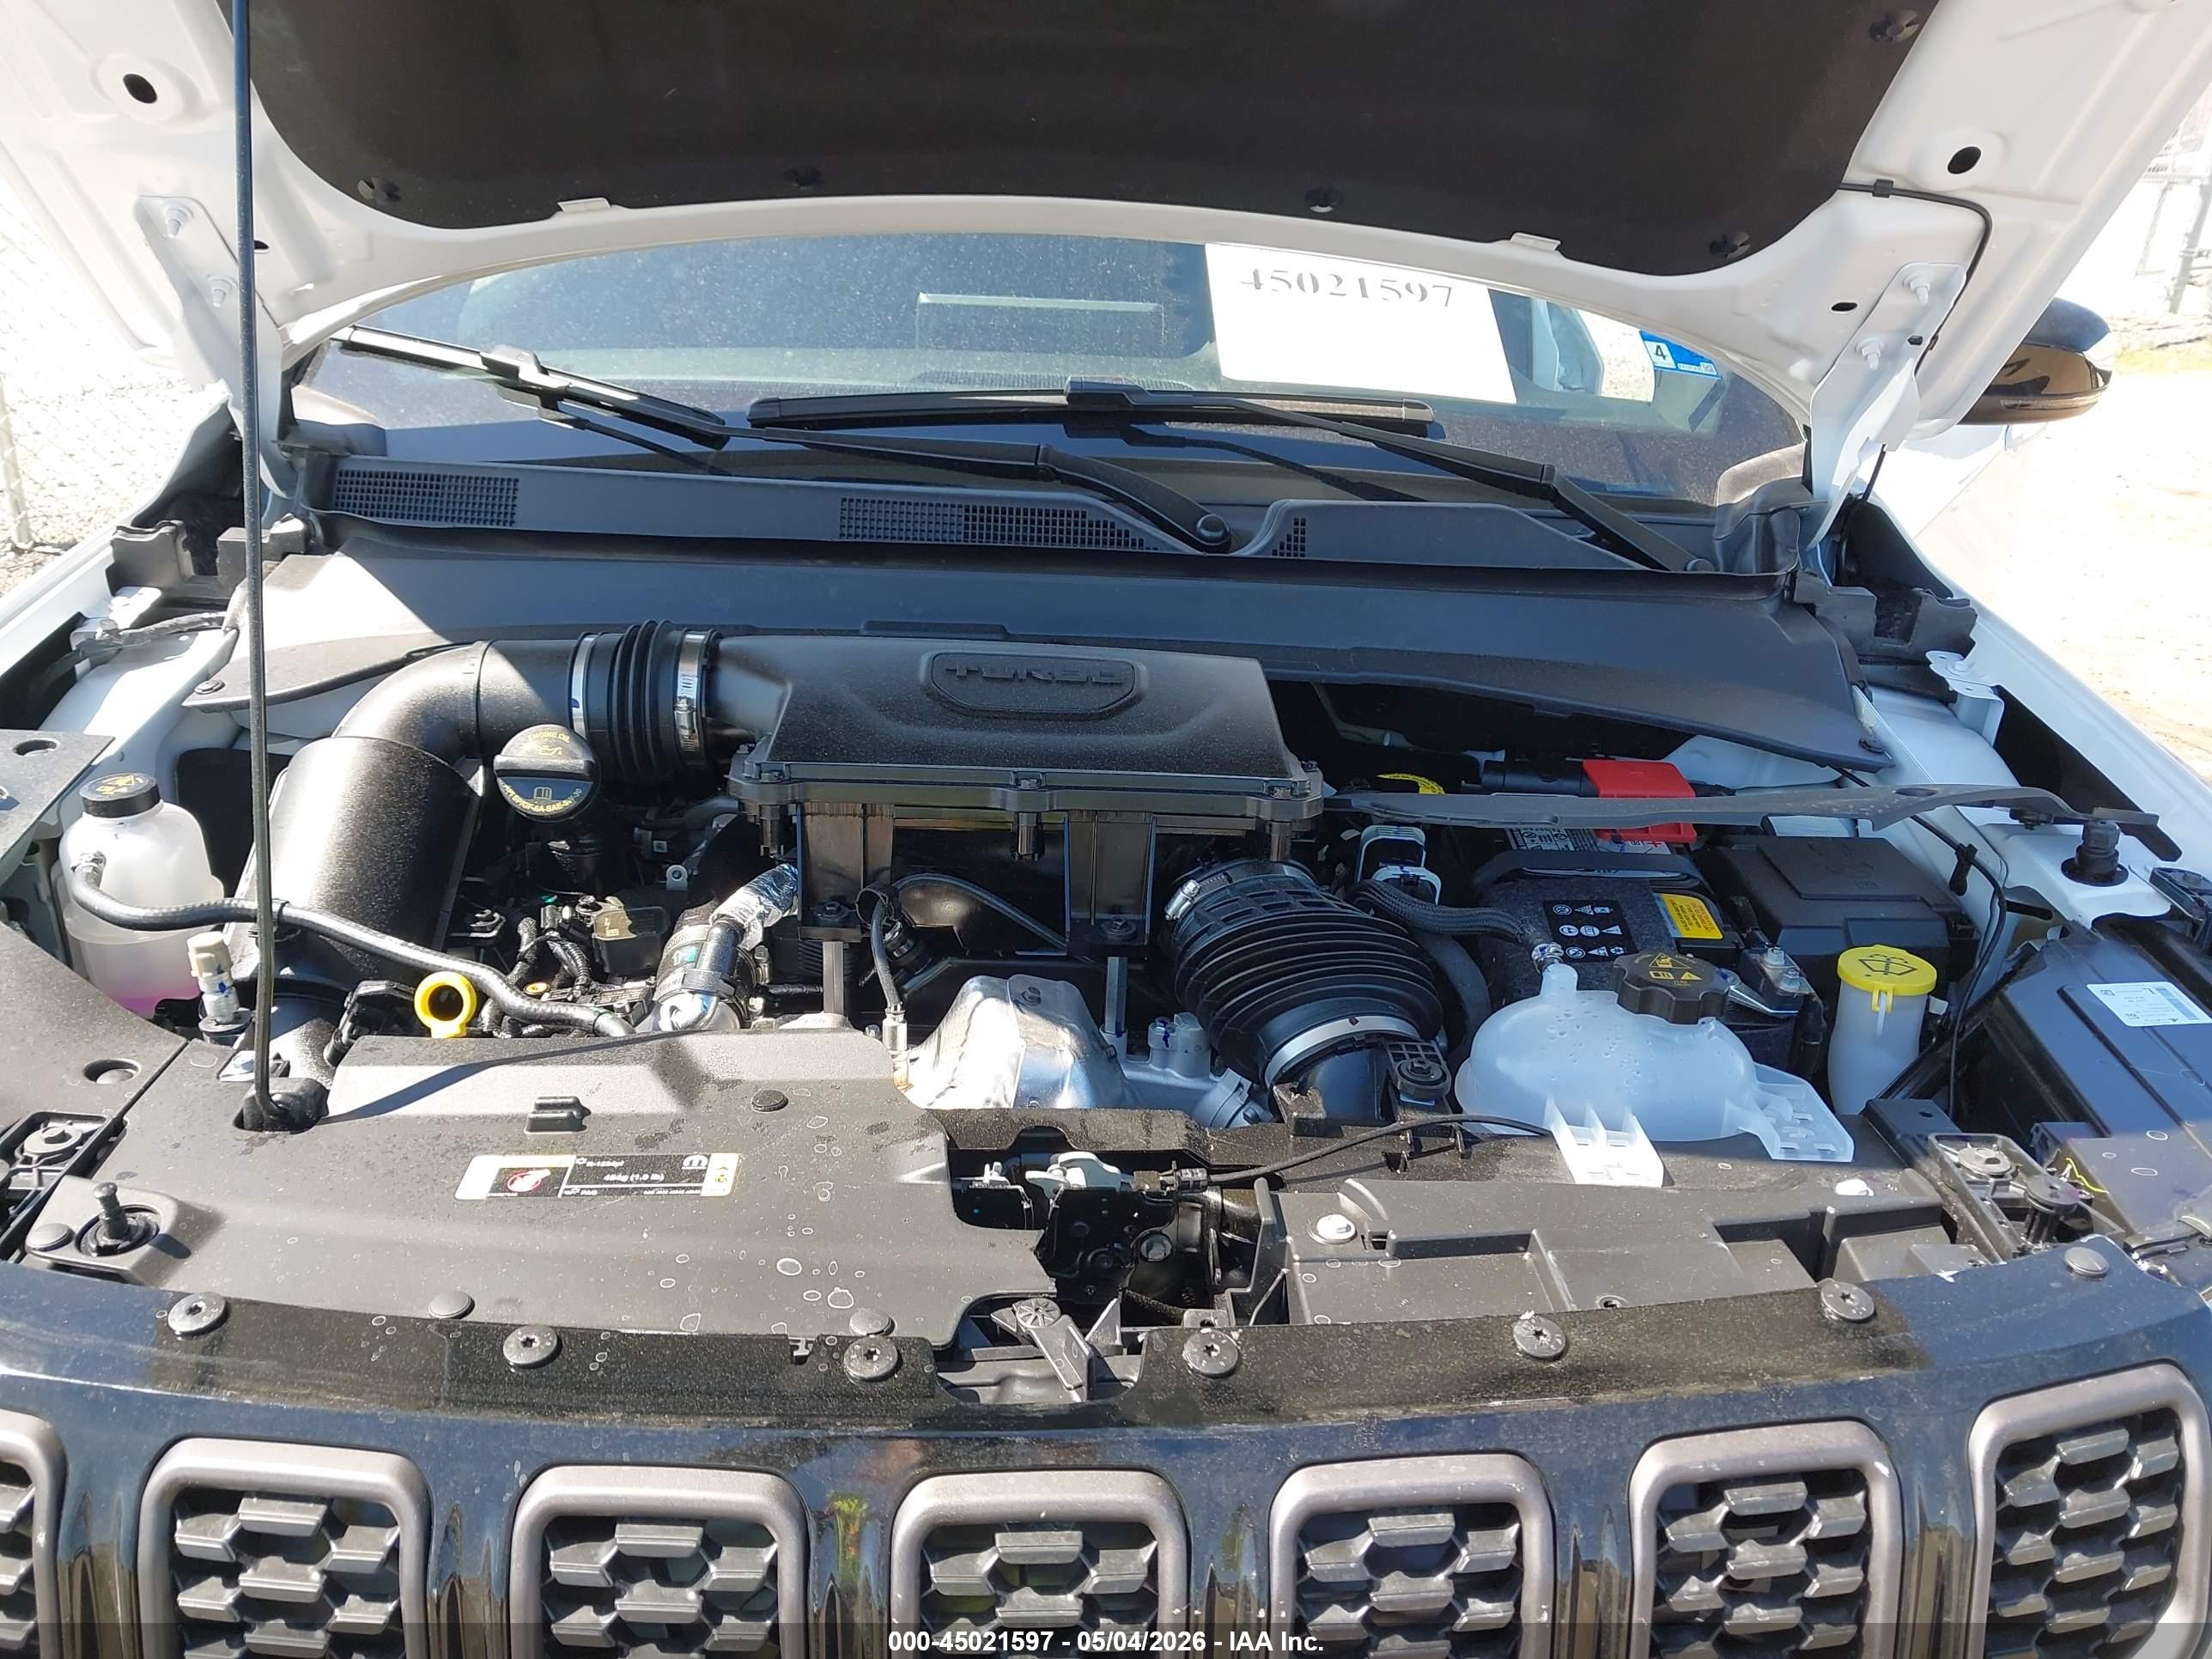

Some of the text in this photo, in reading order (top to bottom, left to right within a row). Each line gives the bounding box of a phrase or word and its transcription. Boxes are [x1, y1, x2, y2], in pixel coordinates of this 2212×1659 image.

[1241, 267, 1455, 308] 45021597
[1655, 344, 1666, 360] 4
[529, 731, 570, 744] ENGINE OIL
